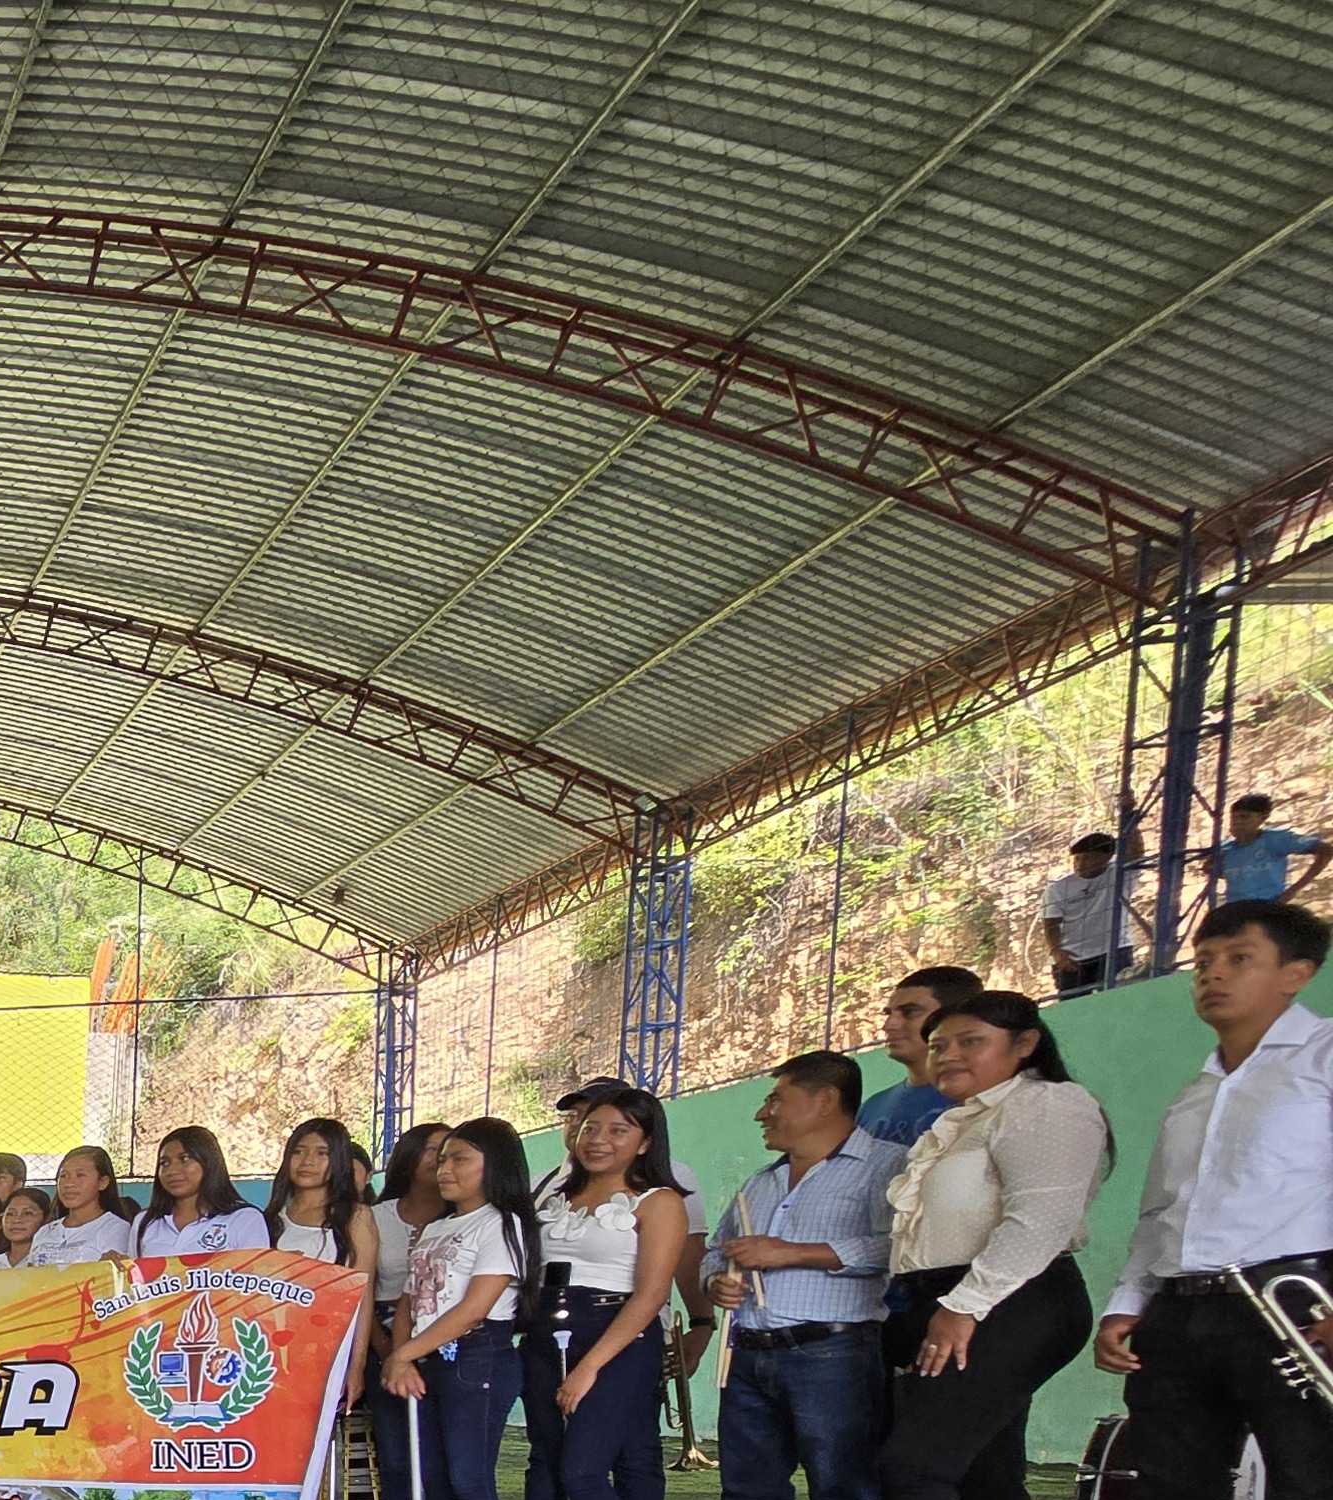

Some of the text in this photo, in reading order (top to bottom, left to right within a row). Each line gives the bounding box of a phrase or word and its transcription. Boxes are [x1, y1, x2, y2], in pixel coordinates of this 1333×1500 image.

[93, 1269, 315, 1320] San Luis Jilotepeque
[151, 1439, 255, 1471] INED
